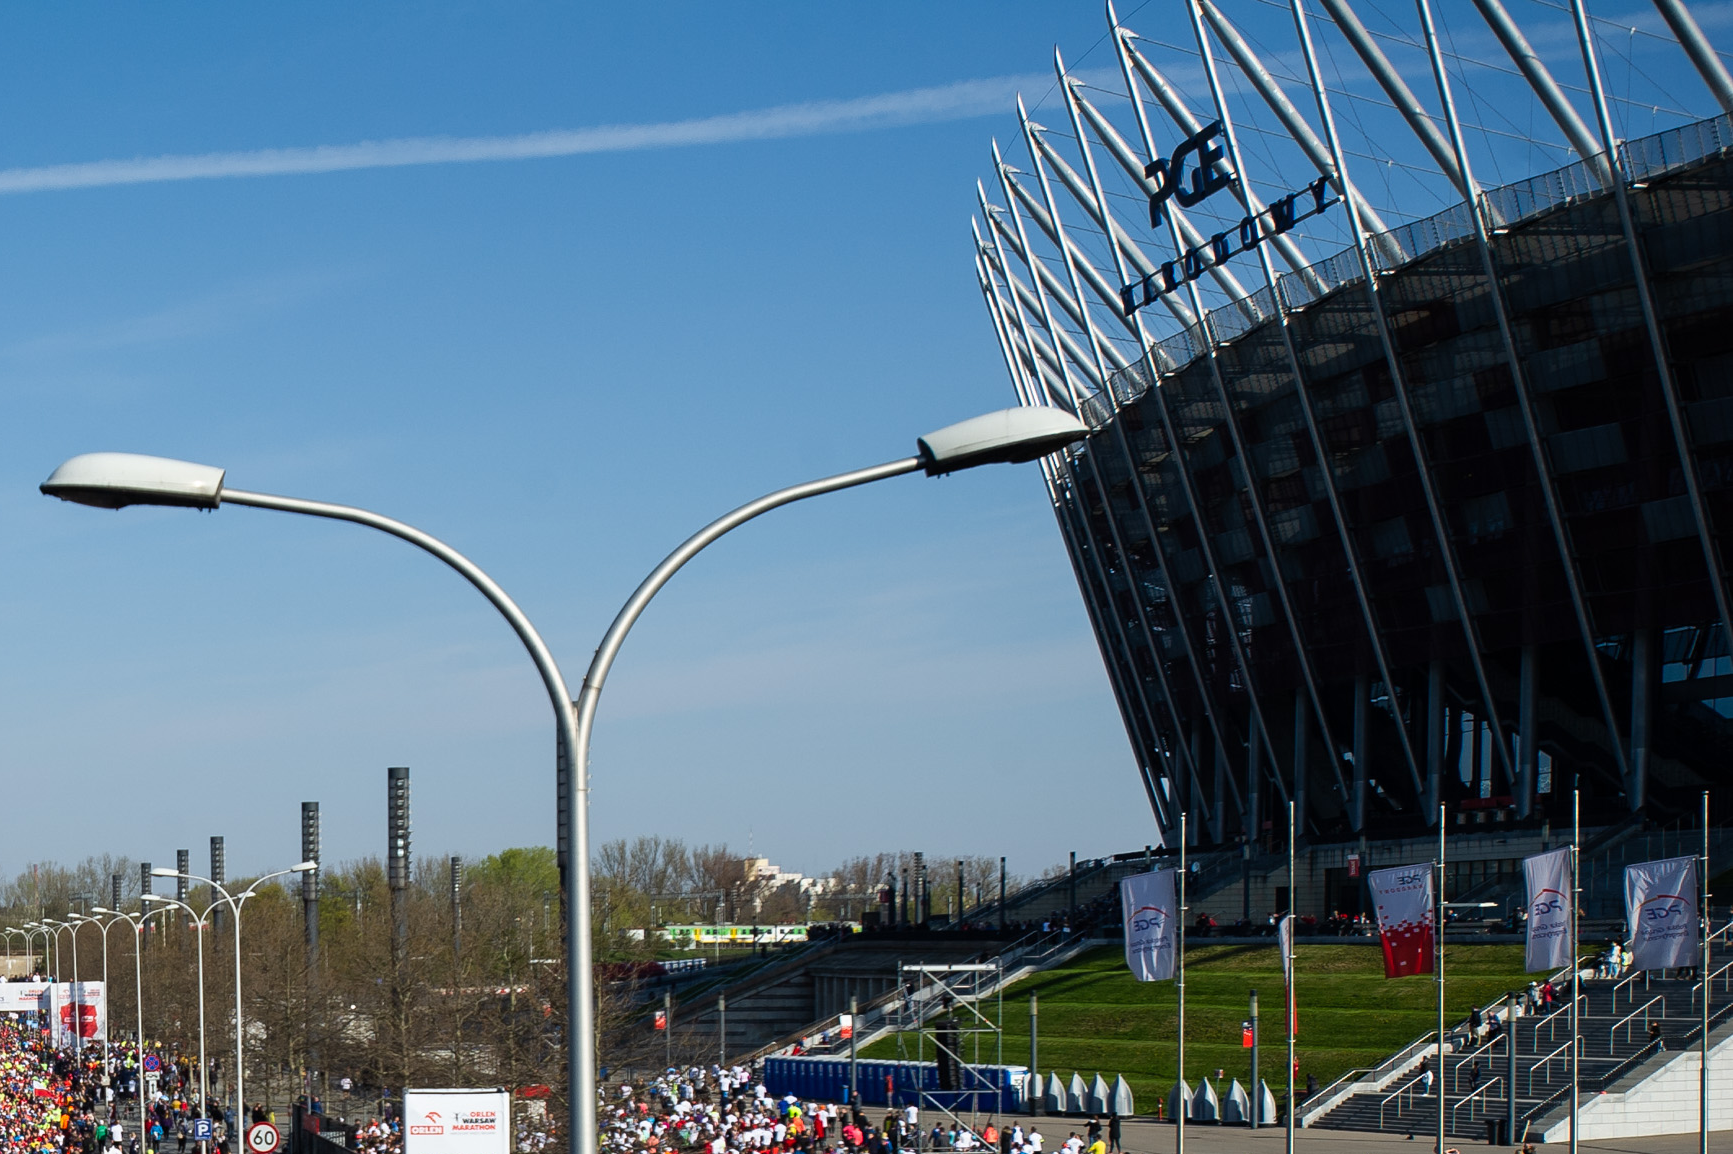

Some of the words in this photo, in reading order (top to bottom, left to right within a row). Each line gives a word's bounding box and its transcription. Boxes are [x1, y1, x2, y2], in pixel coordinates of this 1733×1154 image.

[1144, 119, 1231, 229] PGE
[253, 1129, 275, 1146] 60
[411, 1126, 443, 1134] ORLEN
